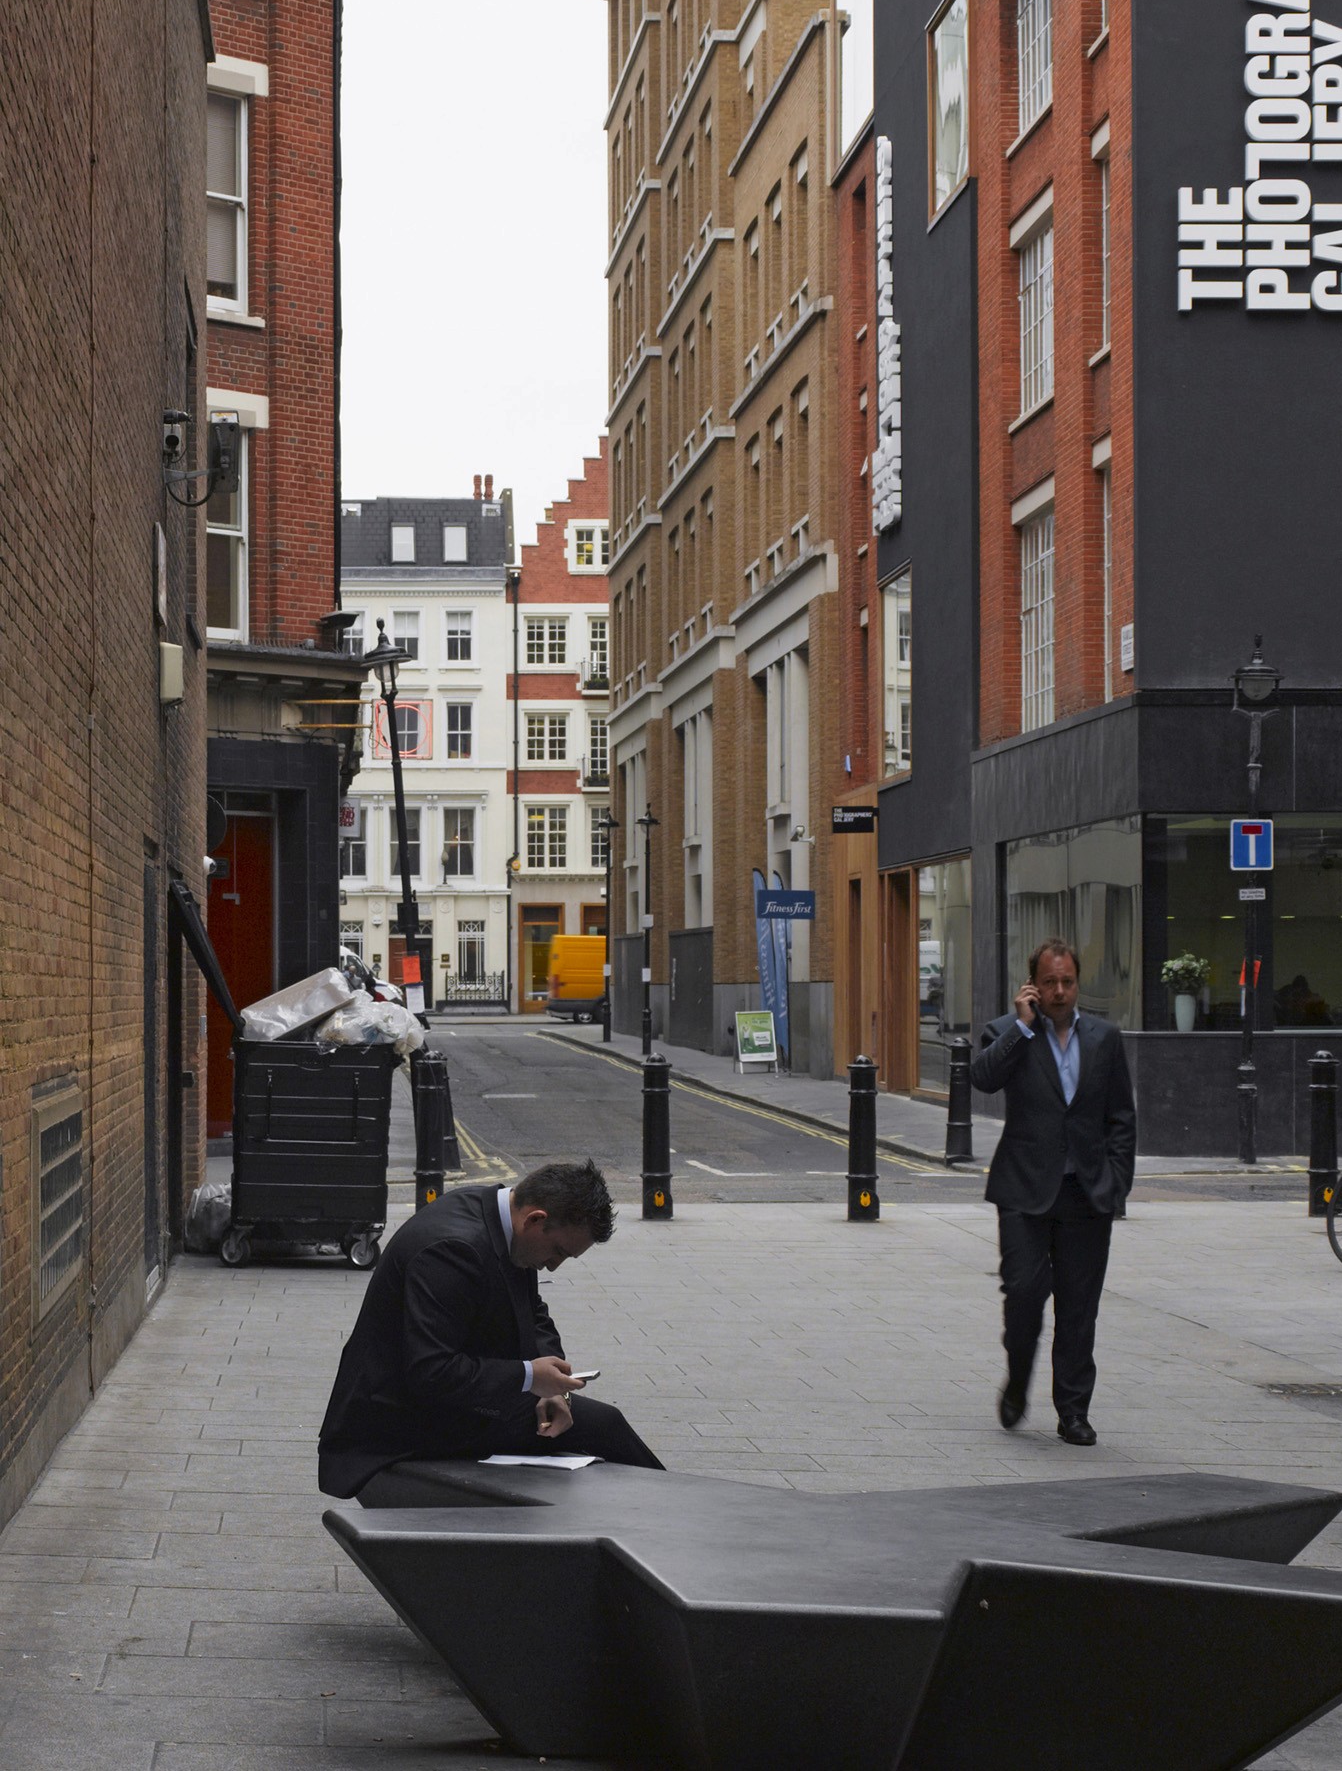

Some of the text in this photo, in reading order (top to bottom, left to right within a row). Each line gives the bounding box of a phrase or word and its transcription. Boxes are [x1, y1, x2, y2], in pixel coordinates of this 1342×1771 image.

[1178, 186, 1243, 312] THE
[762, 901, 812, 915] Fitness First
